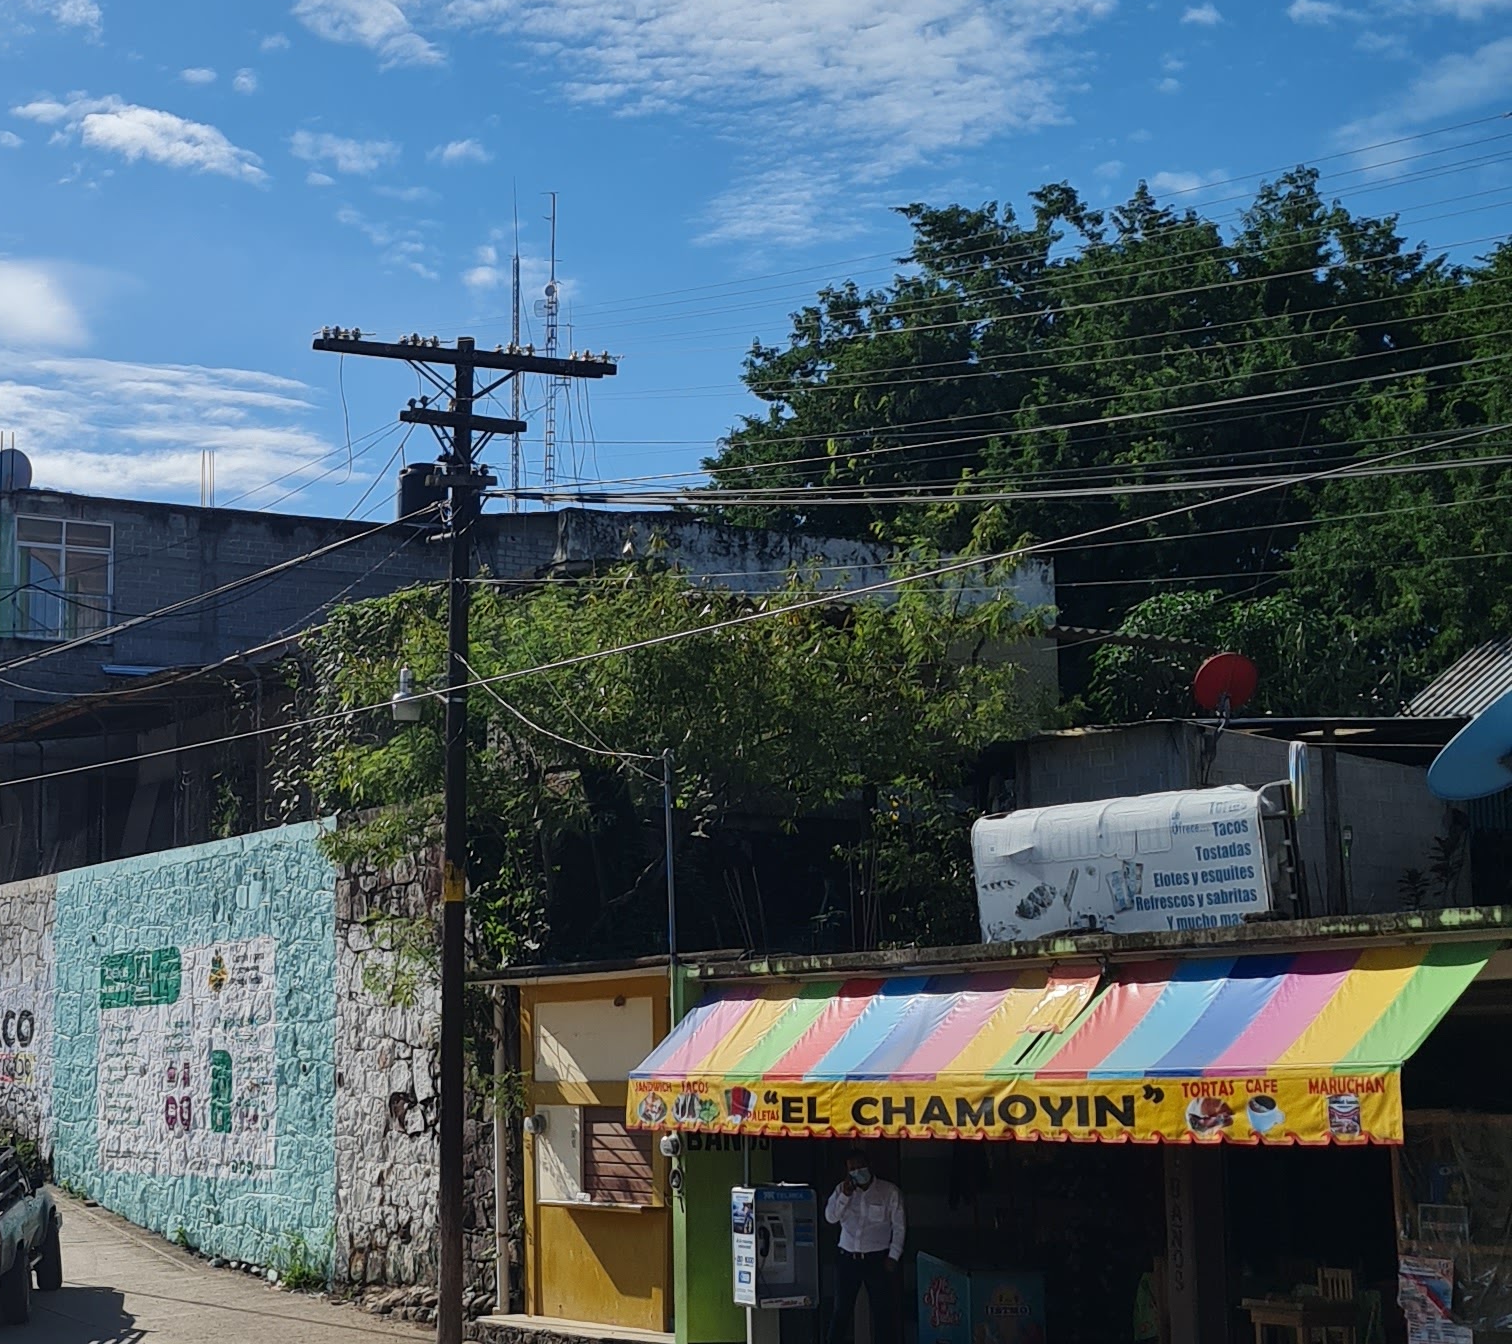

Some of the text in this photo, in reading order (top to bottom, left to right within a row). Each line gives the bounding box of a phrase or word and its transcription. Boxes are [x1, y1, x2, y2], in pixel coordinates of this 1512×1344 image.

[1212, 819, 1249, 837] Tacos
[1195, 842, 1252, 862] Tostadas
[1153, 865, 1255, 888] Elotes y esquites
[1135, 888, 1258, 912] Refrescos y sabritas
[1167, 916, 1174, 930] Y
[1176, 913, 1218, 931] mucho
[634, 1080, 709, 1094] SANDWICH TACOS
[1181, 1076, 1386, 1098] TORTAS CAFE MARUCHAN
[745, 1109, 779, 1122] PALETAS
